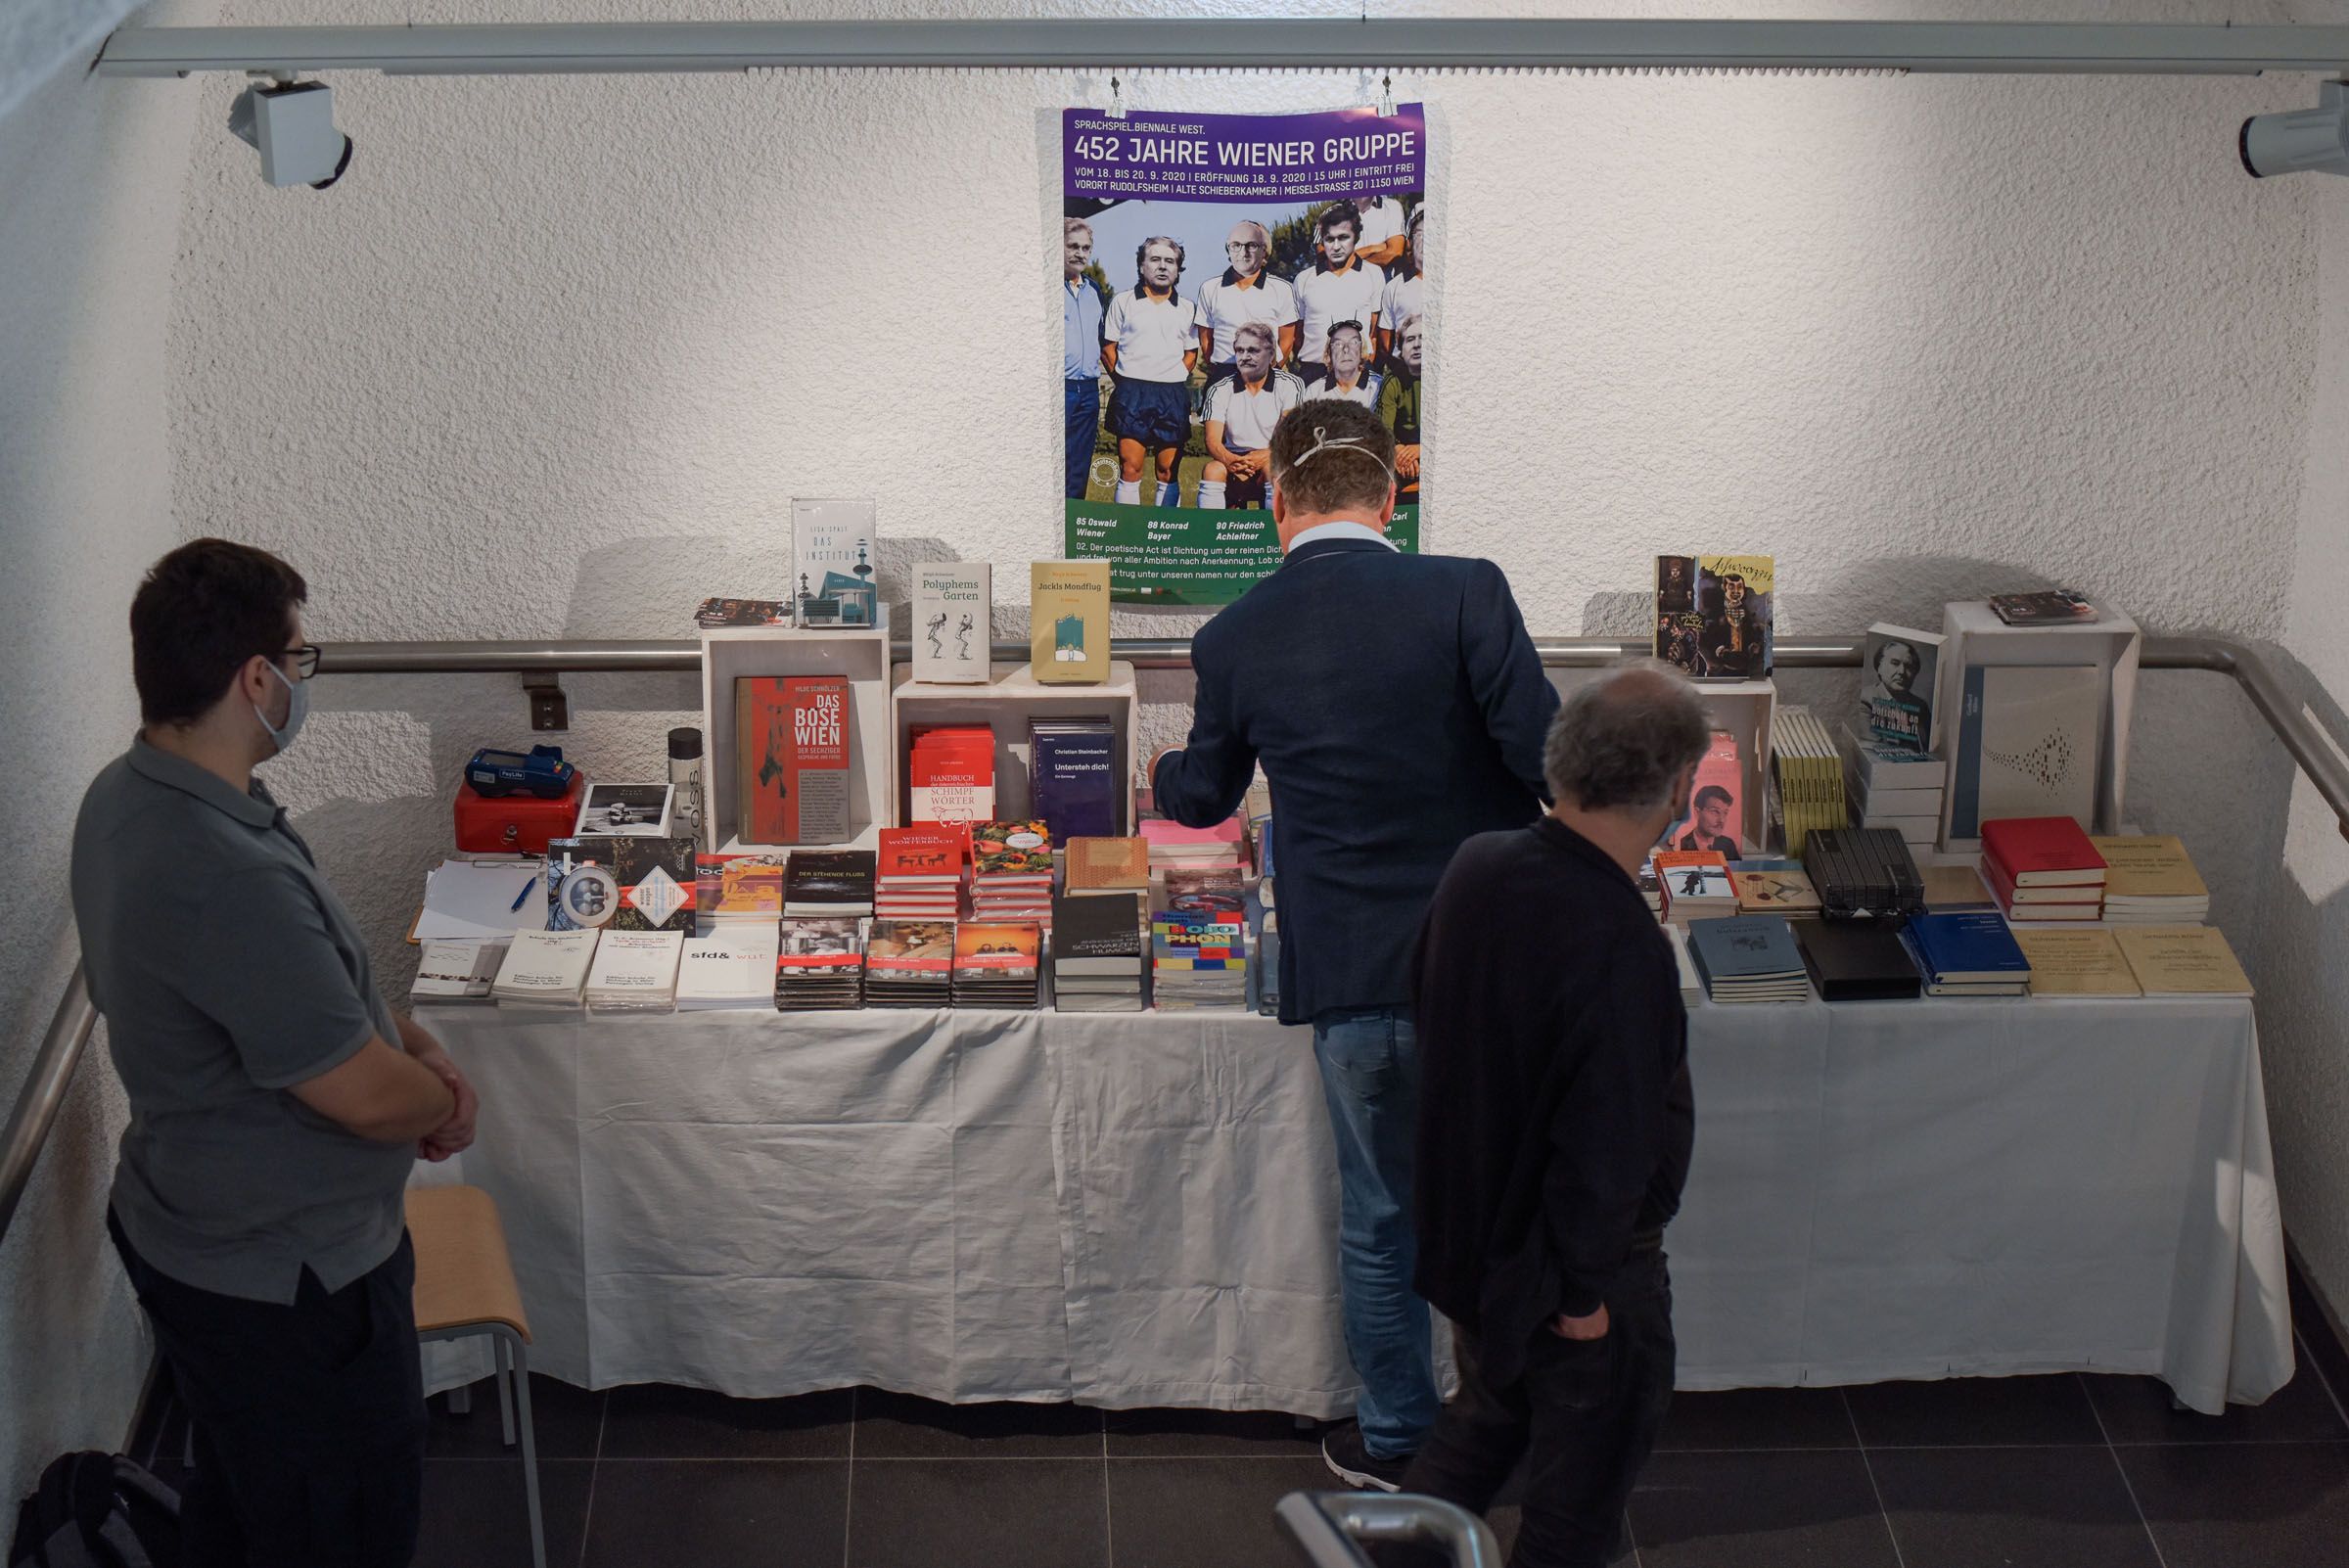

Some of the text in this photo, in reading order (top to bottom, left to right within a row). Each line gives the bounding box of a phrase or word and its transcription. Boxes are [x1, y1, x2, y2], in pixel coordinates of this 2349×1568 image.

[1075, 119, 1206, 135] SPRACHSPIEL.BIENNALE WEST.
[1074, 131, 1415, 166] 452 JAHRE WIENER GRUPPE
[1075, 162, 1415, 184] VOM 18. BIS 20. 9. 2020 ERÖFFNUNG 18. 9. 2020 15 UHR EINTRITT FREI
[1075, 176, 1414, 196] VORORT RUDOLFSHEIM ALTE SCHIEBERKAMMER MEISELSTRASSE 20 1150 WIEN
[1392, 512, 1408, 521] Carl
[1077, 517, 1118, 529] 85 Oswald
[1147, 521, 1189, 530] 88 Konrad
[1216, 521, 1265, 530] 90 Friedrich
[1077, 529, 1106, 538] Wiener
[1147, 531, 1173, 542] Bayer
[1216, 532, 1260, 541] Achleitner
[814, 536, 832, 547] DAS
[1077, 542, 1088, 551] 02.
[1089, 543, 1103, 552] Der
[1105, 544, 1144, 555] poetische
[1145, 545, 1159, 554] Act
[1174, 546, 1209, 556] Dichtung
[1224, 546, 1238, 555] der
[806, 550, 855, 561] INSTITUT
[1143, 557, 1178, 566] Ambition
[1179, 557, 1200, 566] nach
[1201, 557, 1257, 567] Anerkennung,
[1259, 556, 1272, 565] Lob
[1119, 570, 1136, 579] trug
[1137, 571, 1159, 579] unter
[1239, 571, 1255, 579] den
[922, 579, 979, 591] Polyphems
[1037, 582, 1063, 591] Jackls
[1065, 582, 1102, 592] Mondflug
[943, 591, 979, 601] Garten
[816, 694, 840, 709] DAS
[795, 707, 841, 726] BÖSE
[1871, 705, 1918, 724] botschaft an
[1871, 716, 1885, 728] die
[1887, 721, 1918, 734] zukunft
[794, 726, 840, 746] WIEN
[931, 787, 975, 796] SCHIMPF
[689, 769, 701, 846] VOSS
[1165, 934, 1231, 944] PHON
